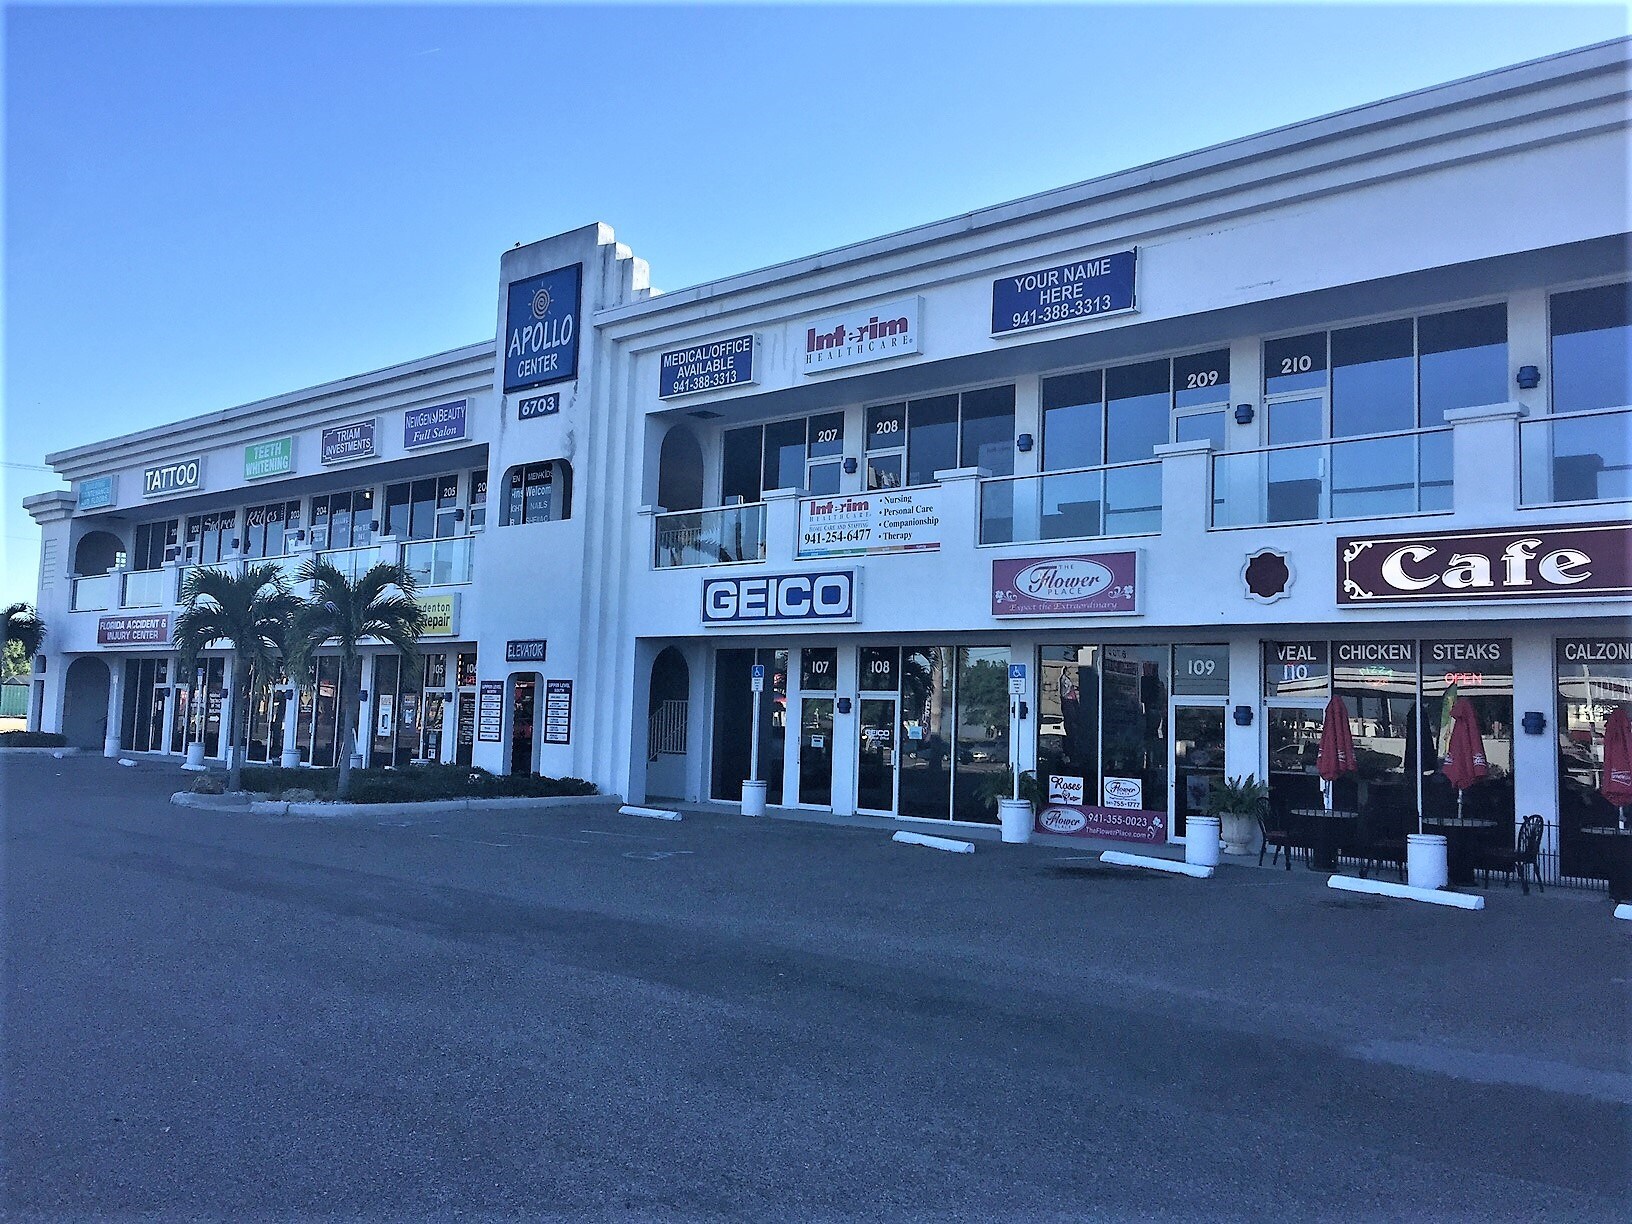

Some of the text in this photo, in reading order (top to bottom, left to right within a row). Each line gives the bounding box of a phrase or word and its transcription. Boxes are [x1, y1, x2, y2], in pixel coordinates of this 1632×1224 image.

[1014, 258, 1111, 293] YOUR NAME
[1039, 282, 1084, 306] HERE
[1012, 294, 1111, 328] 941-388-3313
[508, 313, 574, 358] APOLLO
[807, 316, 908, 353] Interim
[663, 338, 750, 368] MEDICAL/OFFICE
[517, 352, 558, 378] CENTER
[677, 356, 734, 379] AVAILABLE
[1281, 355, 1312, 374] 210
[673, 370, 737, 393] 941-388-3313
[1187, 370, 1219, 389] 209
[522, 396, 555, 416] 6703
[337, 427, 361, 442] TRIAM
[413, 425, 457, 442] Full Salon
[818, 429, 838, 442] 207
[876, 421, 899, 434] 208
[254, 442, 282, 460] TEETH
[326, 437, 371, 456] INVESTMENTS
[246, 456, 289, 476] WHITENING
[146, 463, 197, 491] TATTOO
[443, 487, 456, 497] 205
[477, 482, 487, 492] 20
[884, 495, 912, 505] Nursing
[316, 506, 327, 516] 204
[883, 505, 934, 517] Personal Care
[883, 516, 939, 530] Companionship
[804, 529, 871, 545] 941-254-6477
[883, 531, 912, 541] Therapy
[1381, 538, 1592, 591] Cafe
[1028, 565, 1100, 593] Flower
[706, 575, 850, 619] GEICO
[1047, 587, 1082, 596] PLACE
[1009, 600, 1118, 612] Expect the Extraordinary
[100, 618, 167, 630] FLORIDA ACCIDENT &
[106, 630, 159, 640] INJURY CENTER
[507, 643, 544, 657] ELEVATOR
[1278, 645, 1317, 661] VEAL
[1339, 644, 1411, 660] CHICKEN
[1433, 643, 1501, 660] STEAKS
[1565, 643, 1632, 660] CALZON
[812, 661, 829, 674] 107
[871, 661, 890, 674] 108
[1188, 659, 1216, 676] 109
[1444, 672, 1483, 686] OPEN
[865, 729, 890, 737] GEICO
[1051, 776, 1082, 791] Roses
[1110, 781, 1136, 793] Flower
[1045, 810, 1081, 826] Flower
[1088, 812, 1148, 827] 941-355-0023
[1085, 826, 1147, 838] TheFlowerPlace.com
